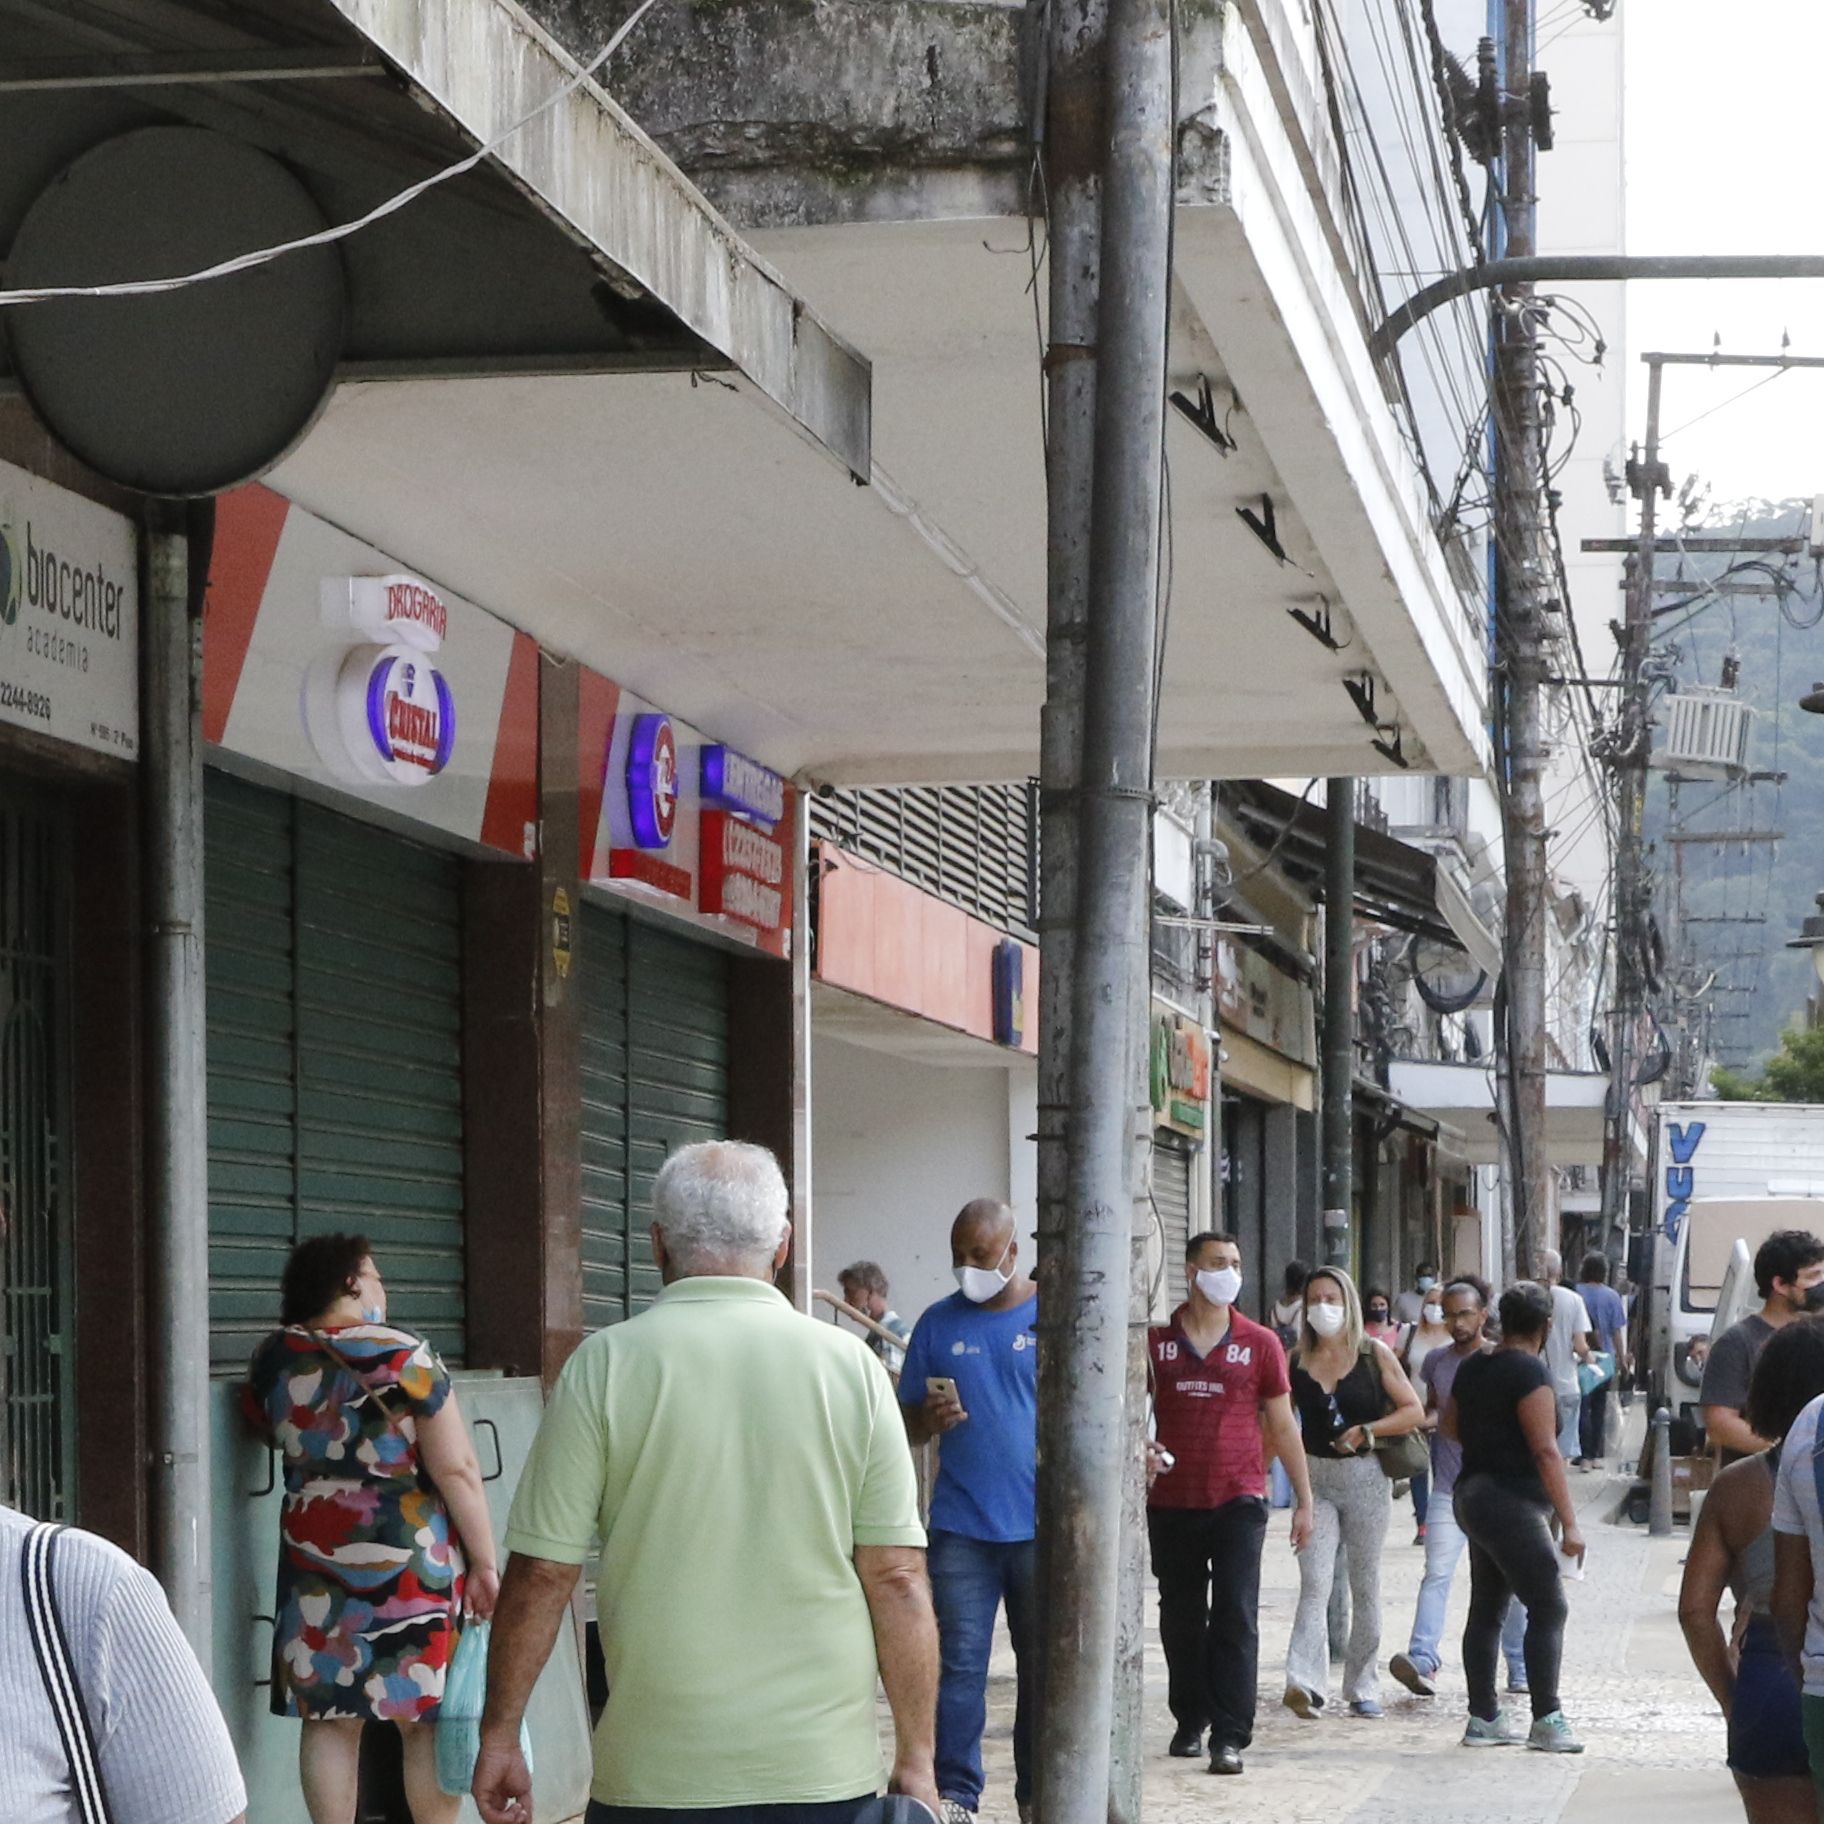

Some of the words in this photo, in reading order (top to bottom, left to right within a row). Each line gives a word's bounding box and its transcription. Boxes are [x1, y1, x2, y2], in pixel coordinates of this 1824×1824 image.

[27, 521, 125, 640] biocenter
[386, 584, 447, 641] DROGARIA
[26, 625, 90, 672] academia
[0, 682, 52, 722] 2244-8926
[388, 690, 439, 750] CRISTAL
[1157, 1340, 1178, 1362] 19
[1226, 1343, 1252, 1367] 84
